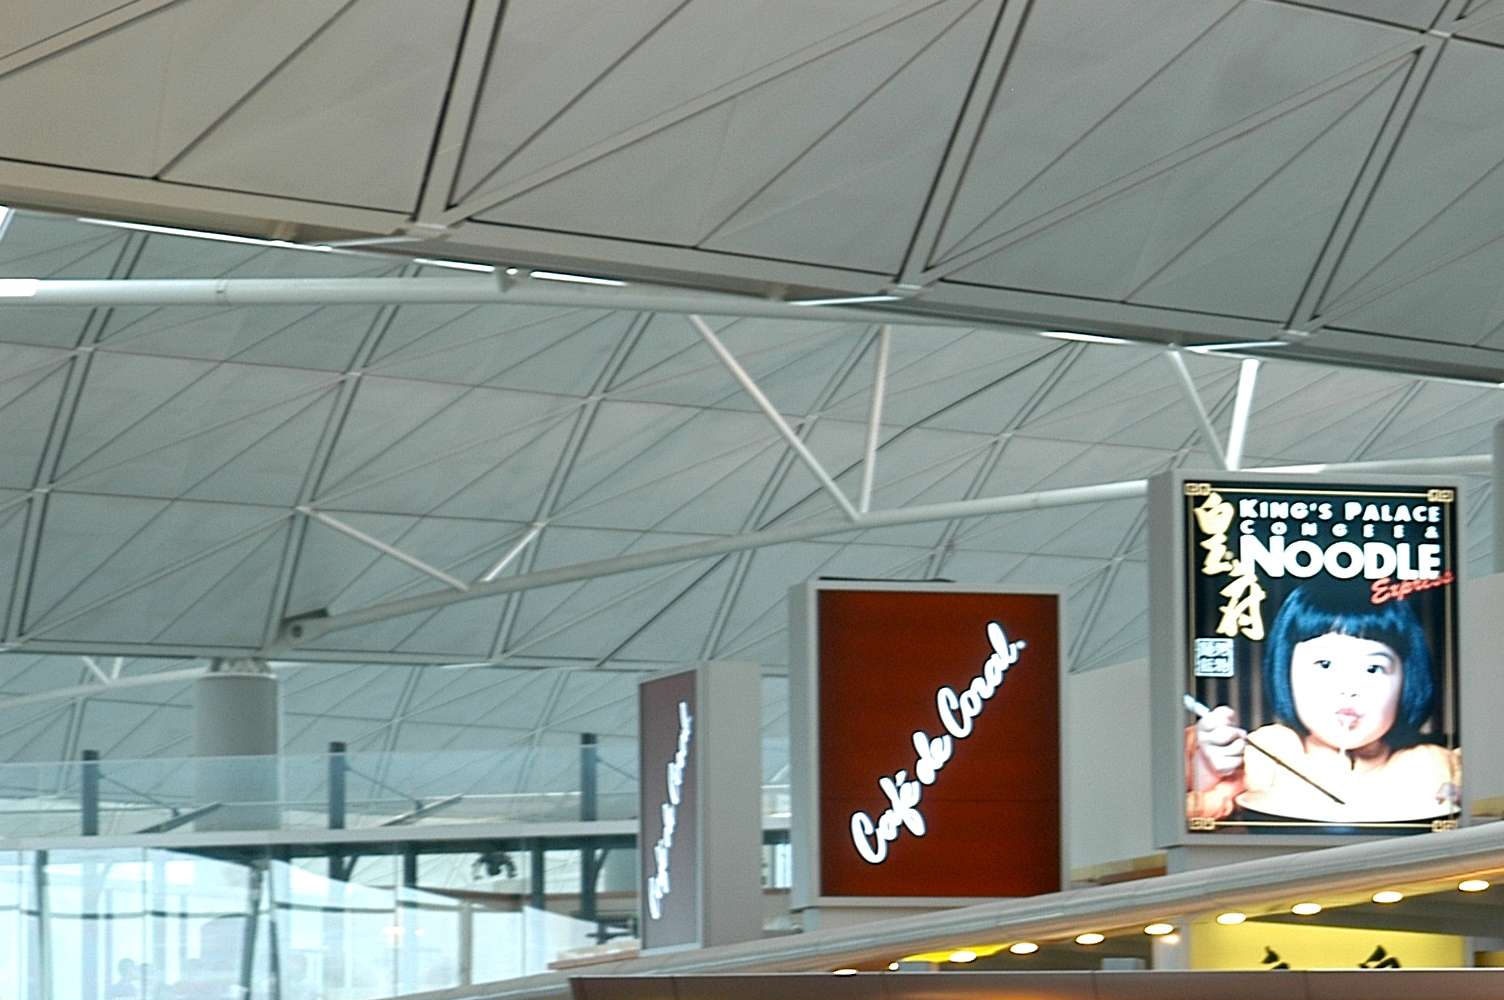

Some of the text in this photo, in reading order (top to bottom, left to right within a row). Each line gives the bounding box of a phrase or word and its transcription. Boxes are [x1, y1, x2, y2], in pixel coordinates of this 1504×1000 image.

[1239, 499, 1441, 523] KING'S PALACE
[1239, 519, 1440, 539] CONGEE &
[1239, 534, 1441, 580] NOODLE
[851, 769, 925, 864] Café
[912, 730, 952, 785] de
